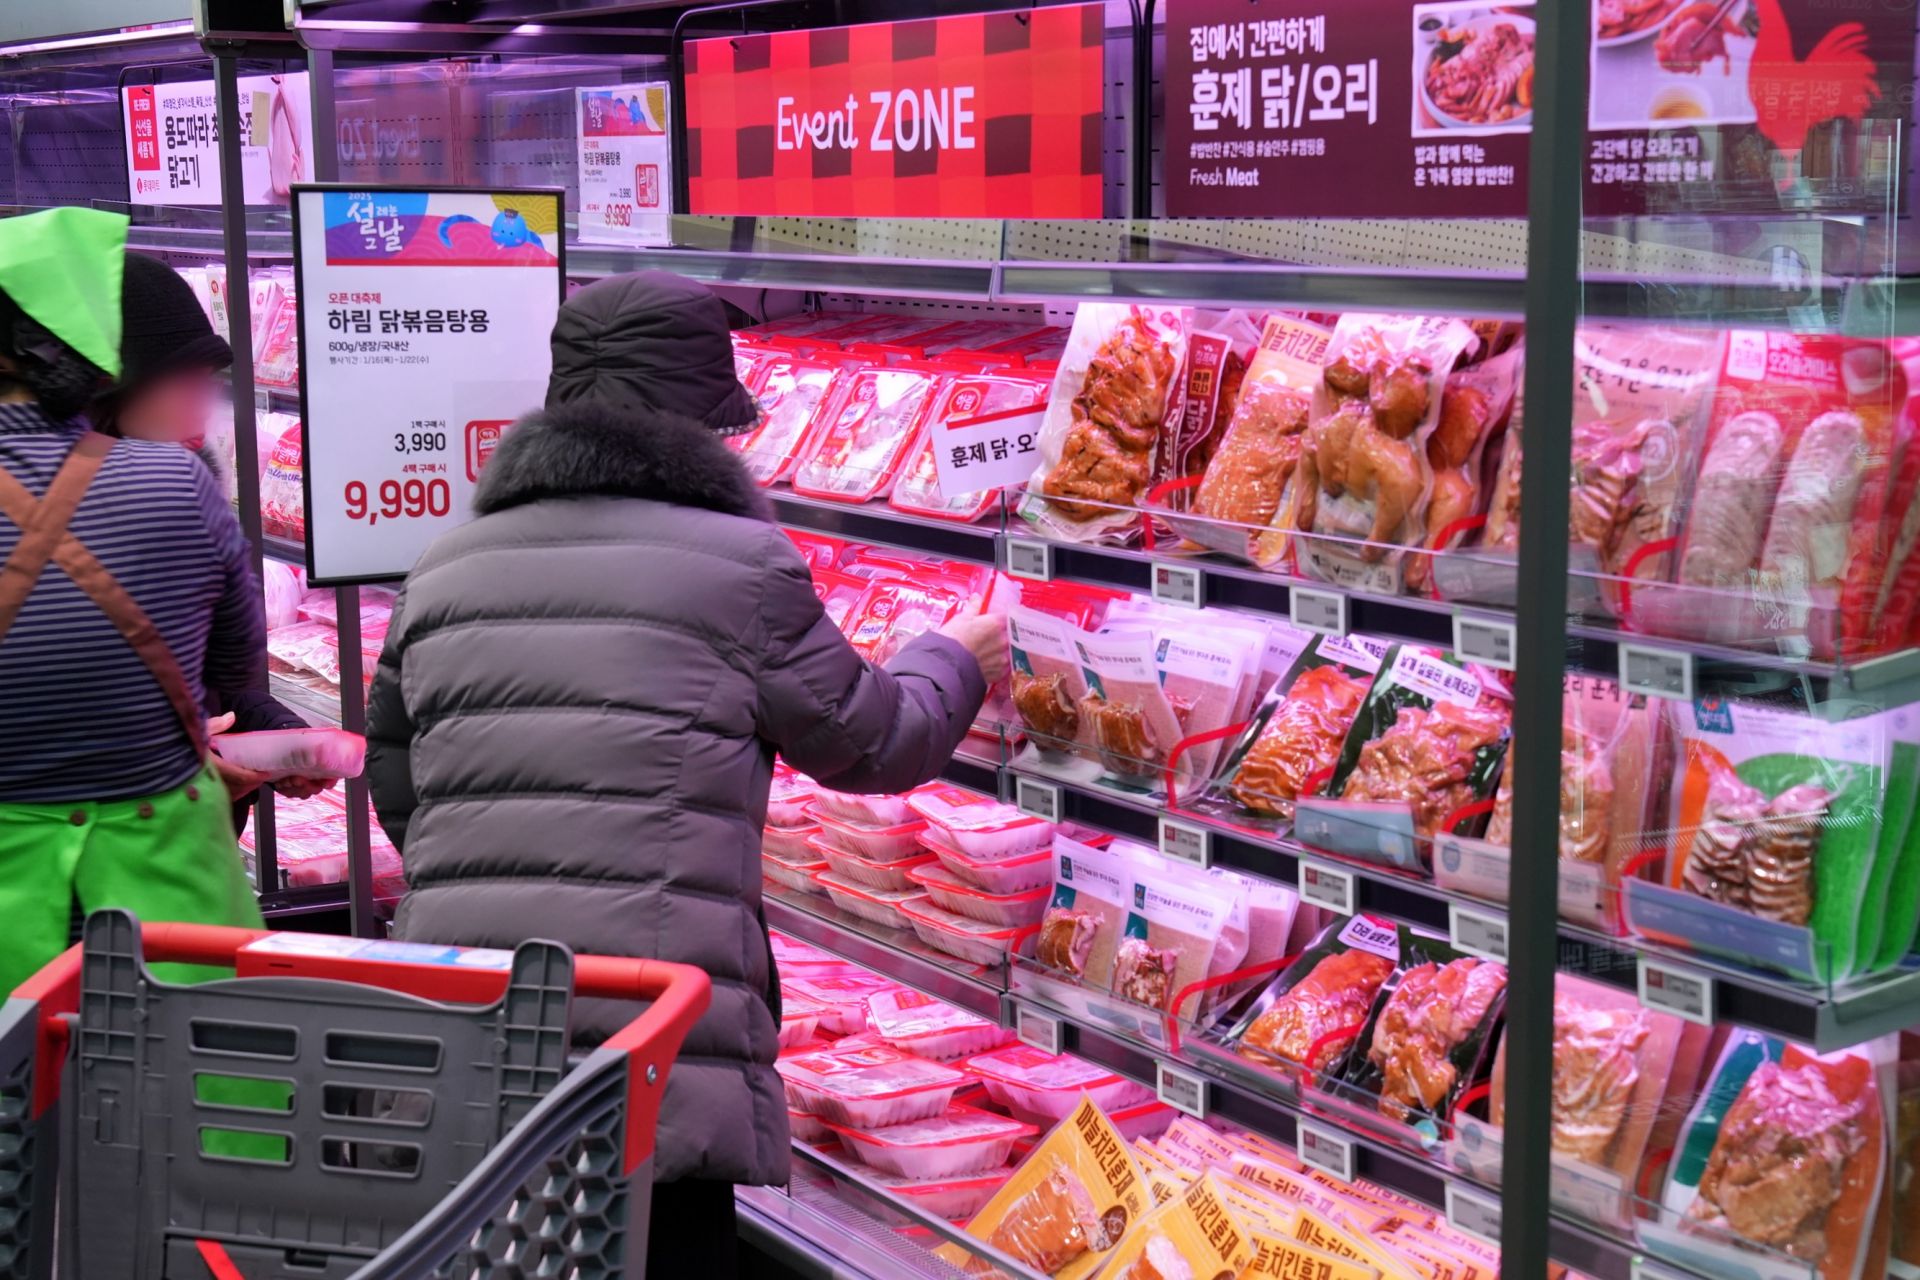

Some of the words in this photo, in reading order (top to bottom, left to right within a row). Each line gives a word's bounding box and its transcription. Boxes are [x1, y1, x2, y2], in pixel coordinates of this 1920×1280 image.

[1190, 24, 1244, 62] 집에서
[1249, 15, 1325, 58] 간편하게
[1189, 67, 1251, 130] 훈제
[1260, 58, 1378, 129] 닭/오리
[165, 113, 209, 149] 용도따라
[777, 93, 859, 150] Event
[869, 86, 976, 152] ZONE
[1190, 142, 1222, 159] #밥반찬
[1223, 140, 1256, 158] #간식용
[1256, 139, 1290, 157] #술안주
[1291, 138, 1326, 156] #캠핑용
[1414, 146, 1437, 165] 밥과
[1438, 145, 1460, 164] 함께
[1462, 144, 1486, 164] 먹는
[1590, 140, 1629, 160] 고단백
[1645, 136, 1699, 158] 오리고기
[167, 154, 200, 189] 닭고기
[1190, 167, 1223, 186] Fresh
[1225, 167, 1260, 187] Meat
[1414, 167, 1427, 187] 온
[1427, 167, 1450, 187] 가족
[1451, 167, 1474, 186] 영양
[1475, 165, 1515, 187] 밥반찬!
[1590, 163, 1641, 184] 건강하고
[1642, 161, 1682, 183] 간편한
[328, 292, 349, 305] 오픈
[351, 292, 382, 305] 대축제
[328, 309, 371, 333] 하림
[379, 309, 490, 333] 닭볶음탕용
[328, 340, 410, 353] 600g/냉장/국내산
[423, 420, 438, 430] 구매
[394, 432, 447, 455] 3,990
[950, 440, 987, 468] 훈제
[990, 431, 1039, 459] 닭·오
[402, 463, 418, 473] 4팩
[418, 463, 437, 474] 구매
[438, 462, 447, 473] 시
[344, 478, 451, 526] 9,990
[1075, 1102, 1136, 1199] 마늘치킨훈제
[1186, 1181, 1240, 1262] 늘치킨훈제
